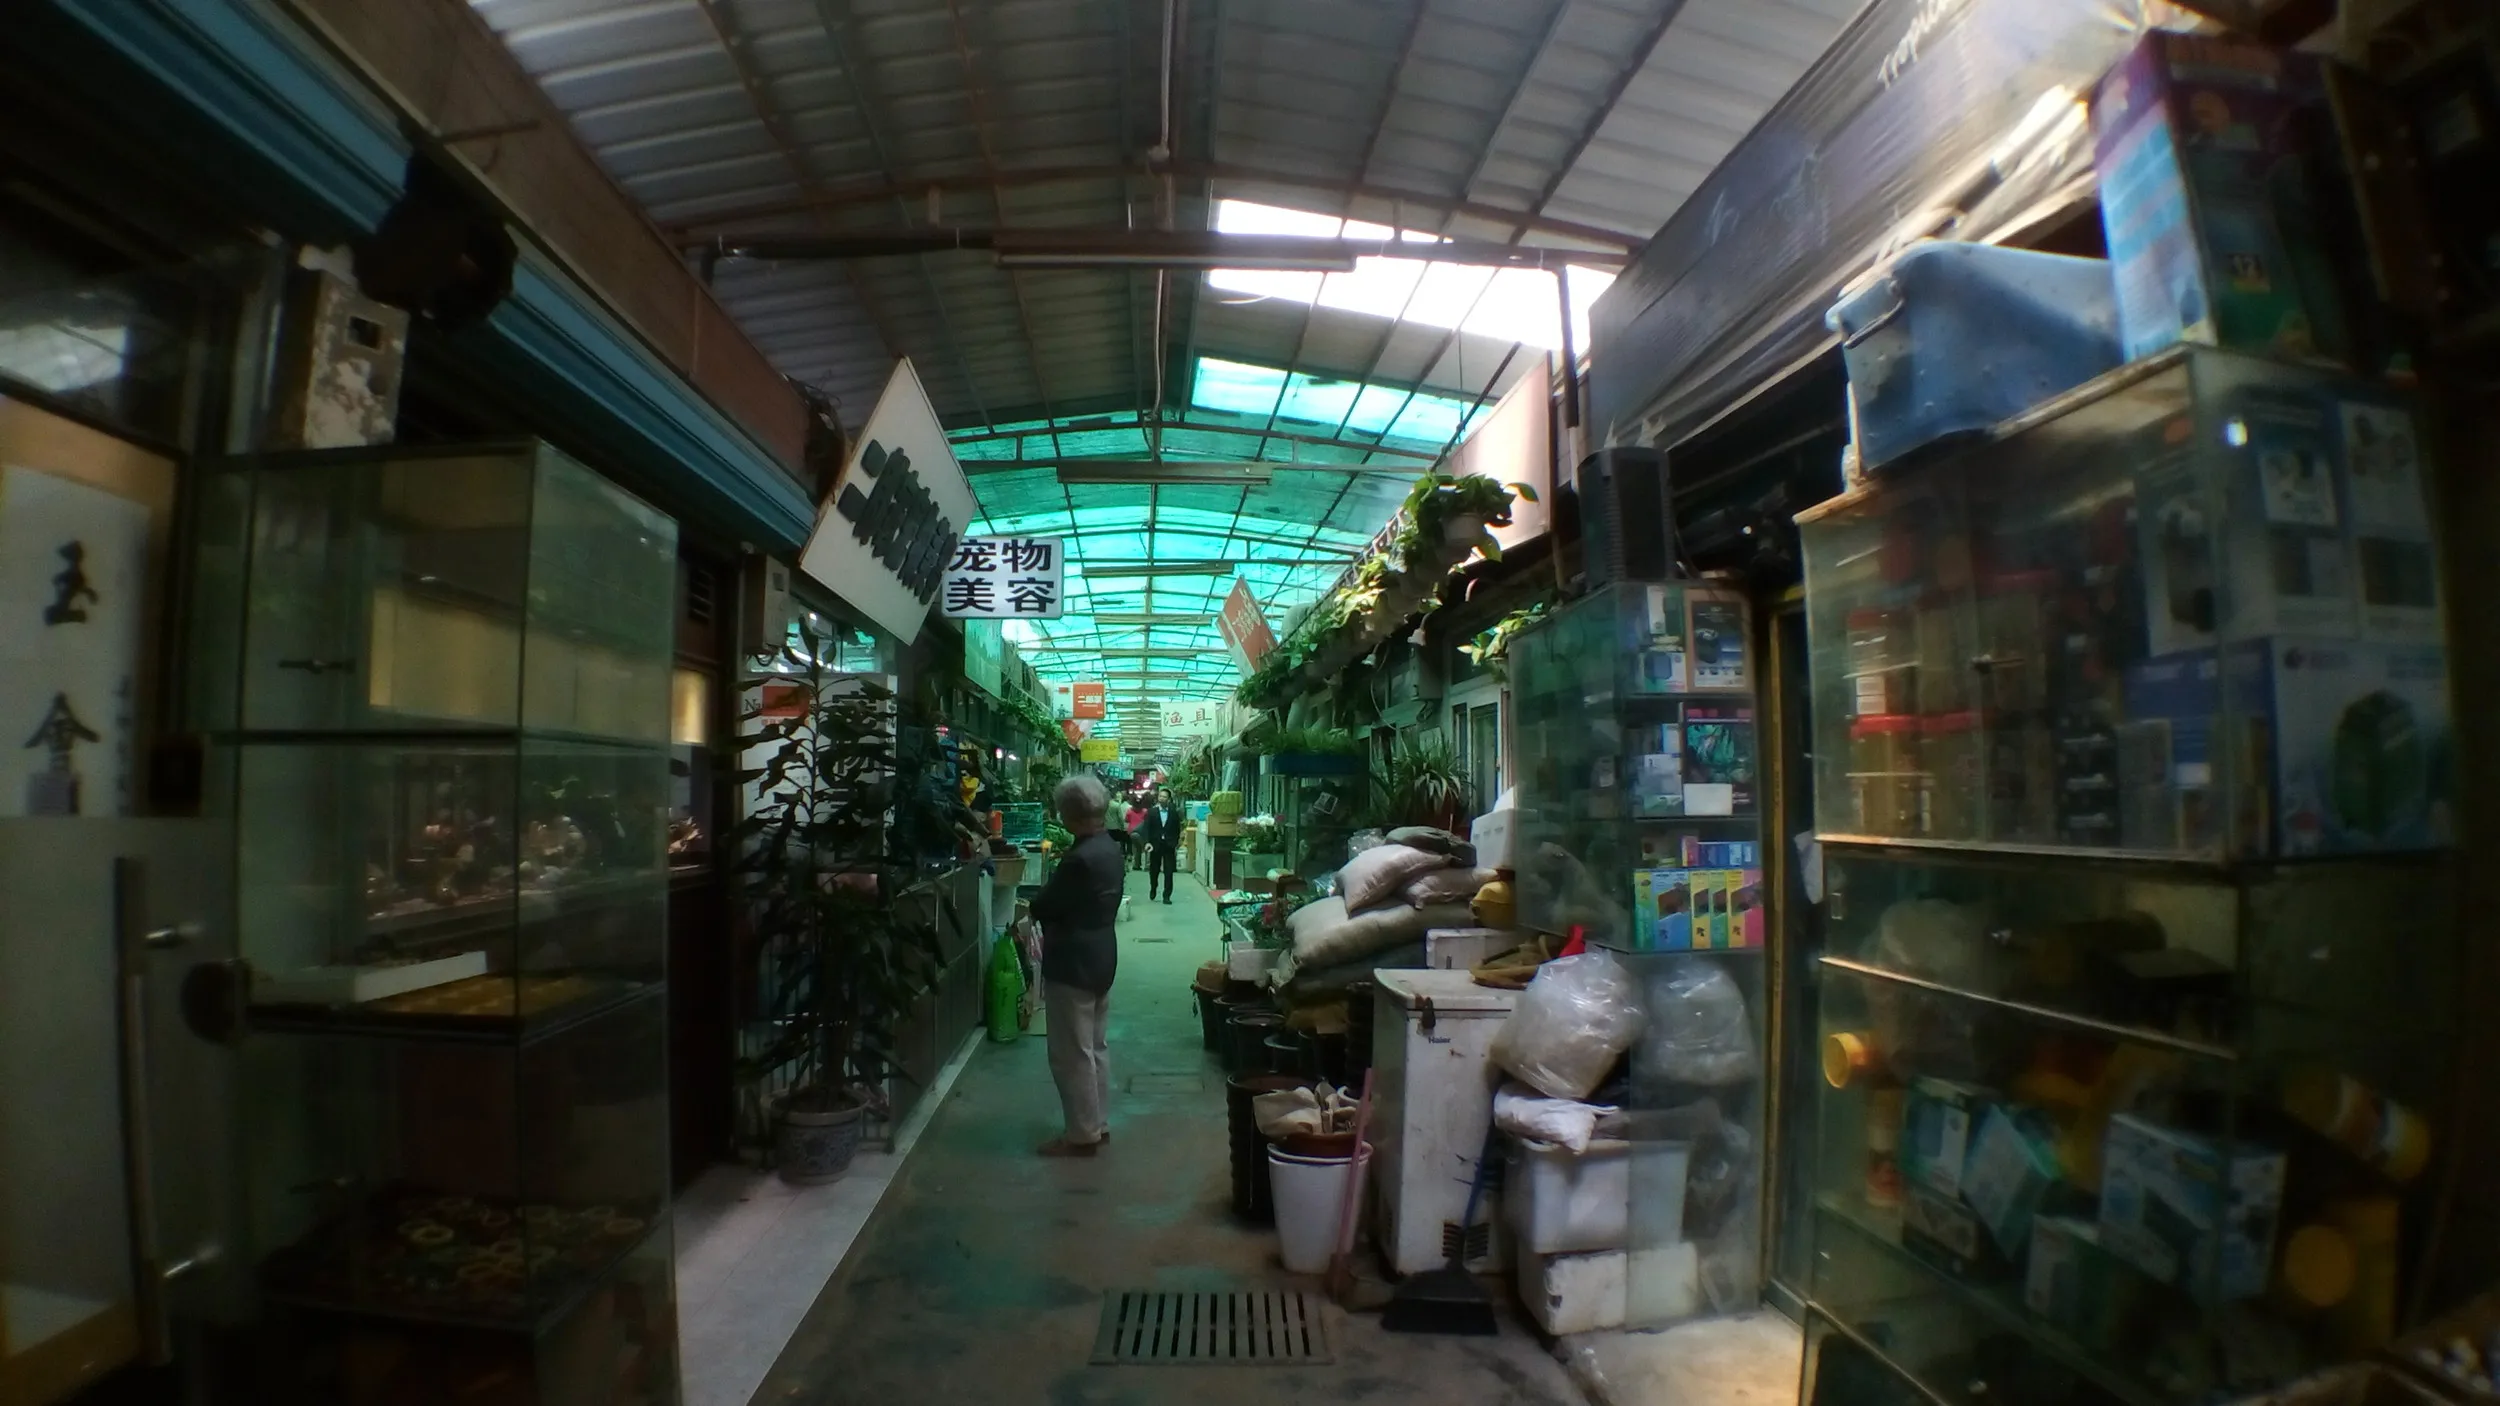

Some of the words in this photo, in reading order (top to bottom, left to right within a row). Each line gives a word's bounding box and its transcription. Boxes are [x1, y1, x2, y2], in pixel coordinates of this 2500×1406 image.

[948, 539, 1052, 574] 宠物
[946, 577, 1057, 613] 美容
[1164, 708, 1212, 727] 渔具
